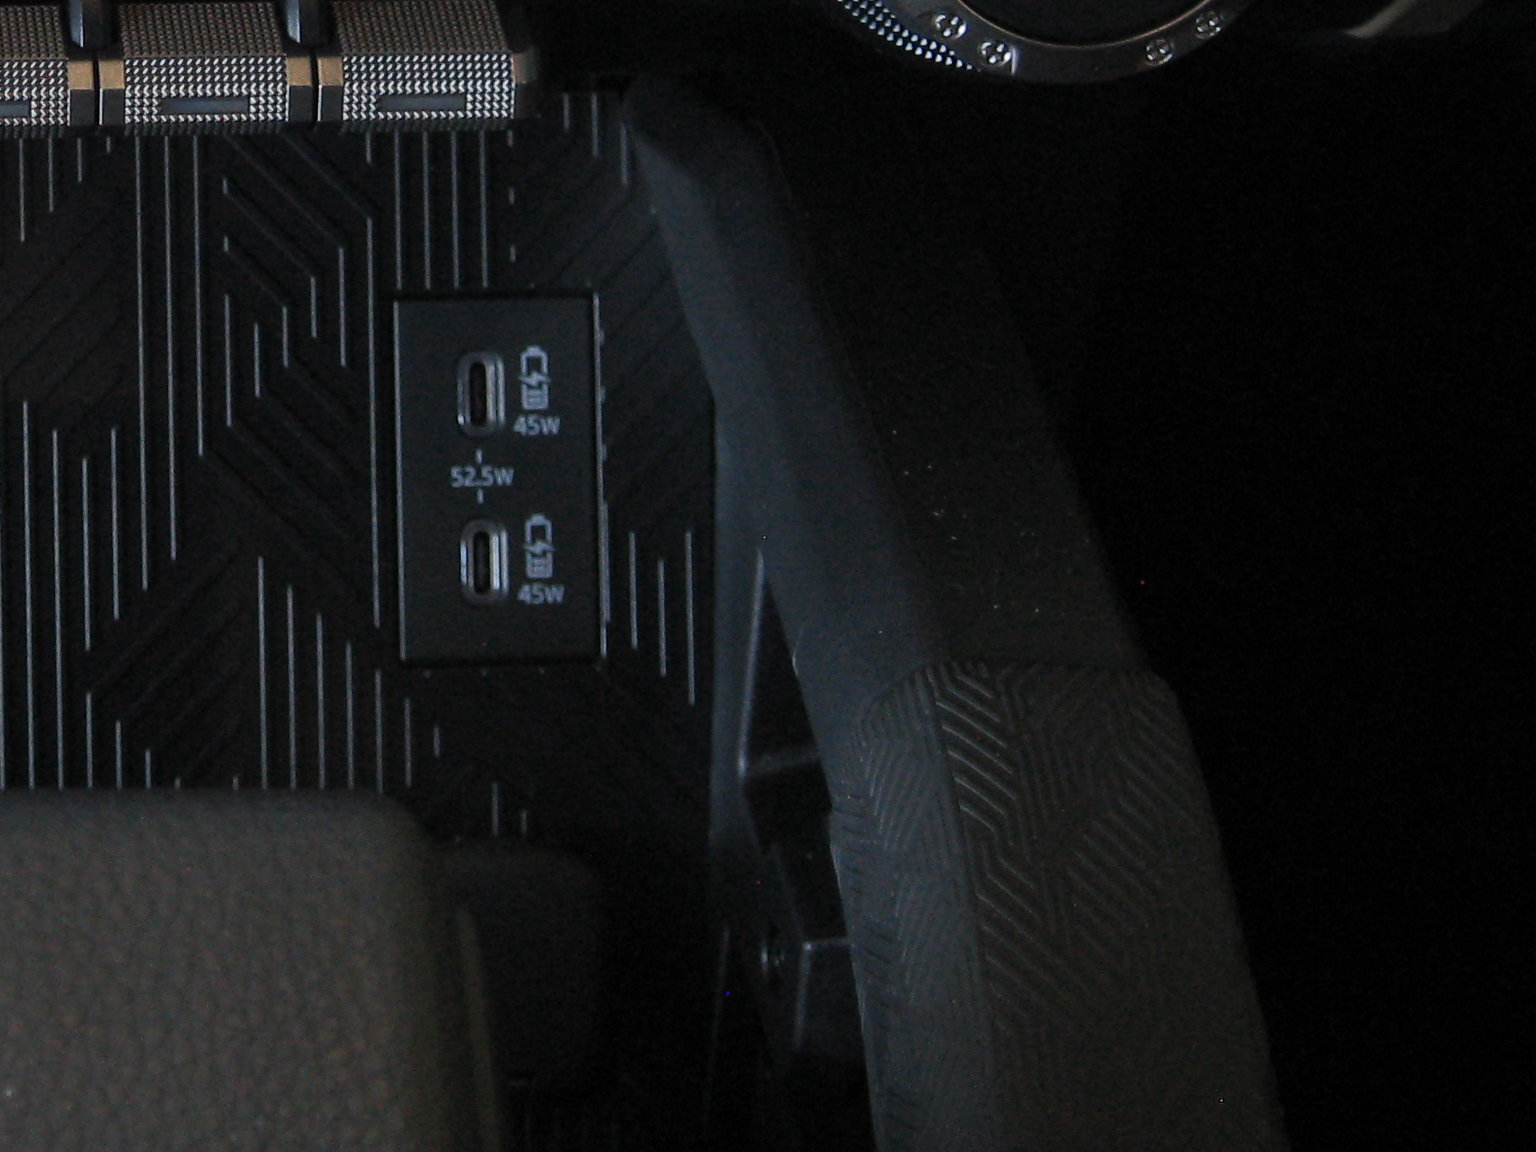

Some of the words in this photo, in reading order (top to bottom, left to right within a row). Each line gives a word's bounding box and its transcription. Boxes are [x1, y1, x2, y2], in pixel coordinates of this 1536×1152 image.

[513, 415, 560, 435] 45W
[450, 465, 514, 488] 52.5W
[517, 583, 565, 605] 45W
